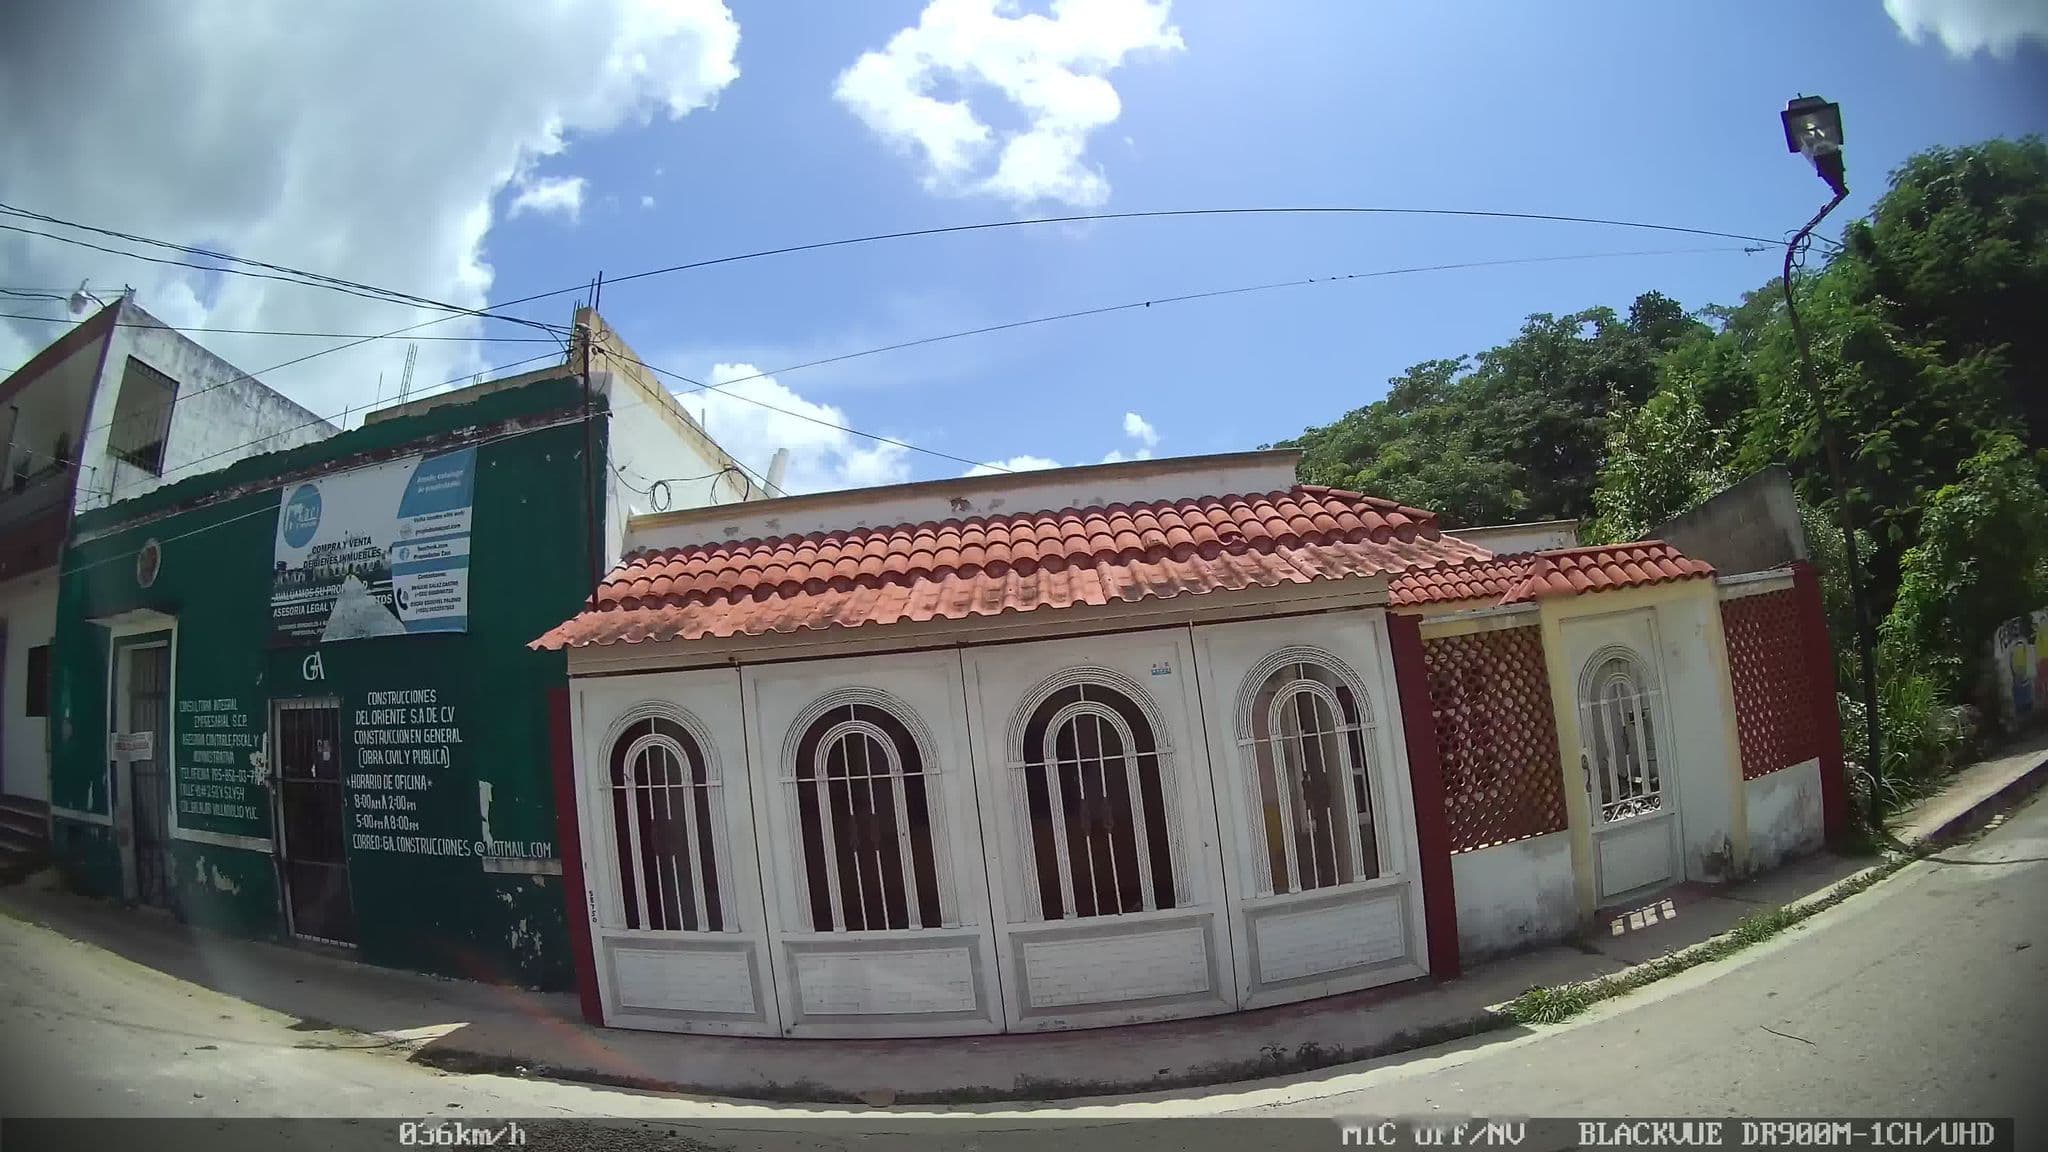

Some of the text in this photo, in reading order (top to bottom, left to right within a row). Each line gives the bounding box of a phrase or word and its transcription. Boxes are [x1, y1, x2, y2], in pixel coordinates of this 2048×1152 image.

[311, 542, 341, 554] COMPRA
[349, 536, 372, 548] VENTA
[313, 555, 338, 567] BIENES
[339, 547, 382, 563] INMUEBLES
[273, 605, 305, 618] ASESORIA
[306, 603, 328, 614] LEGAL
[367, 689, 437, 706] CONSTRUCCIONES
[355, 710, 369, 725] DEL
[371, 708, 406, 725] ORIENTE
[426, 707, 437, 723] DE
[354, 728, 463, 745] CONSTRUCCION EN GENERAL
[385, 749, 403, 765] CIVIL
[403, 749, 411, 765] Y
[383, 774, 393, 789] DE
